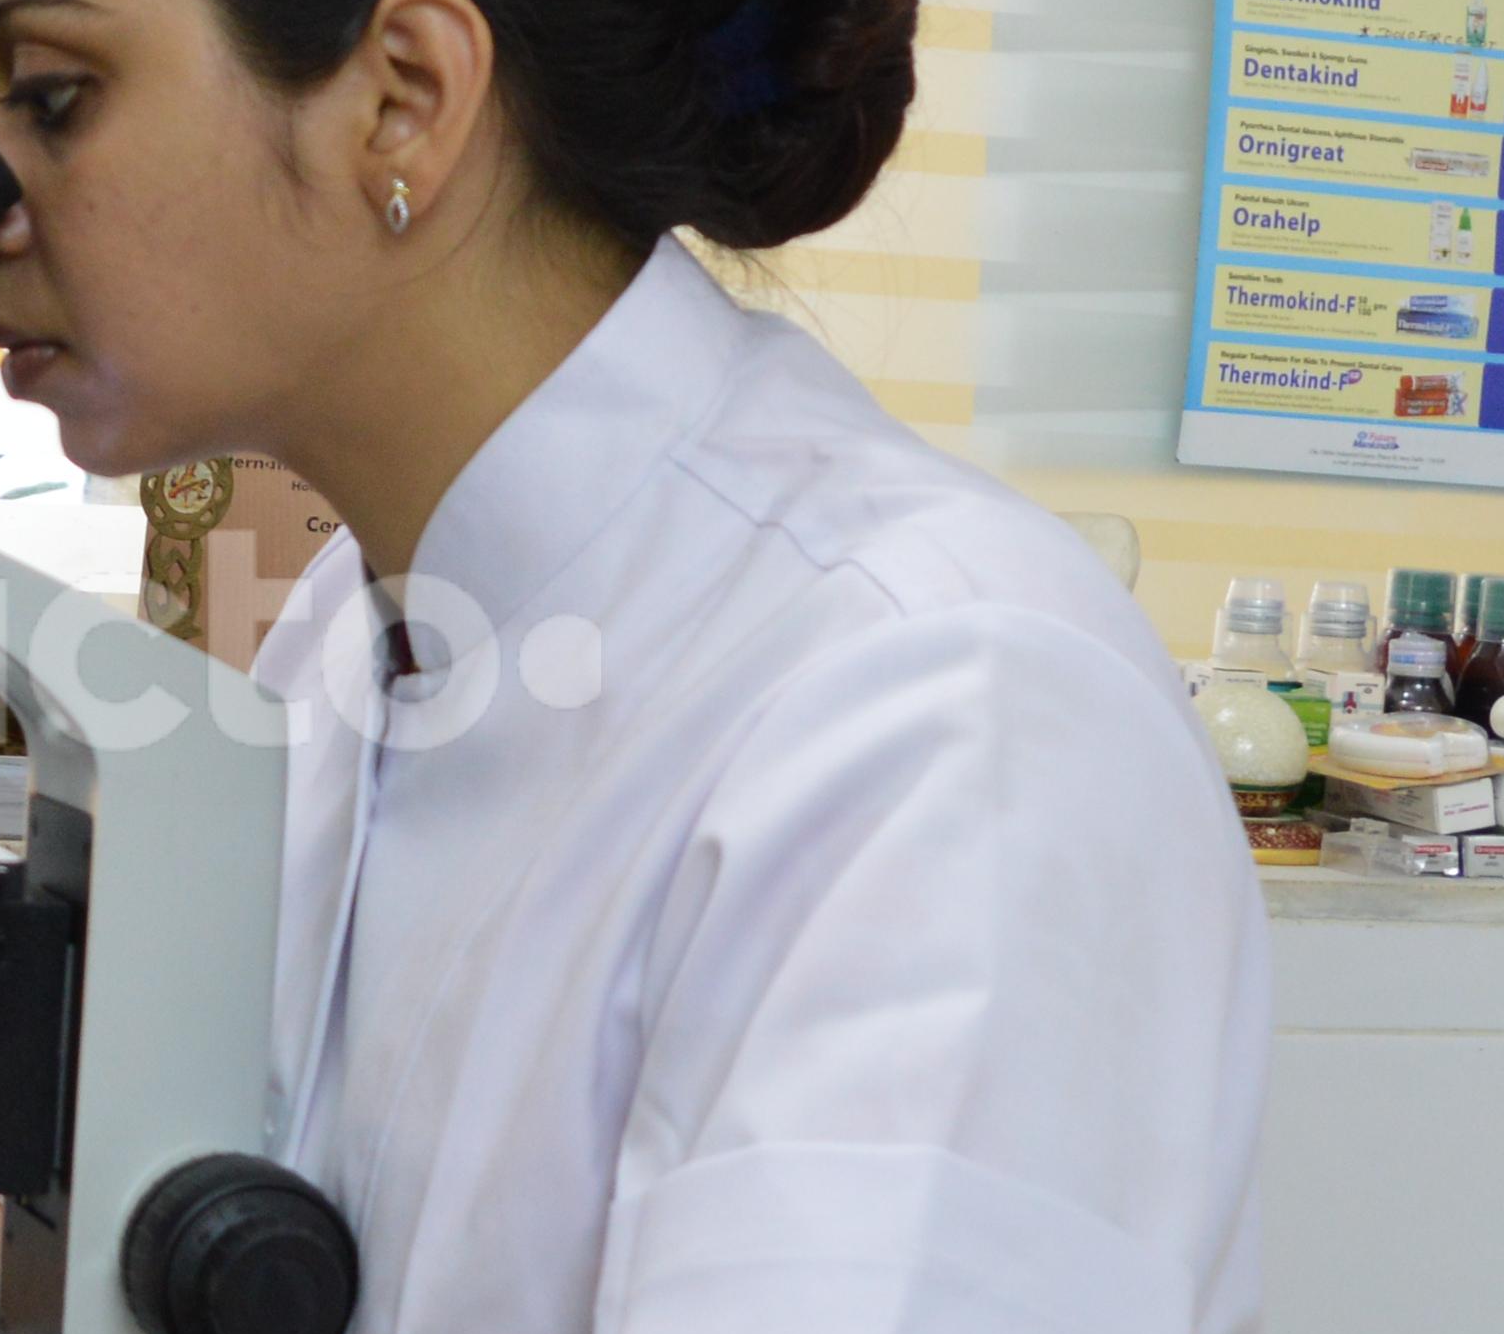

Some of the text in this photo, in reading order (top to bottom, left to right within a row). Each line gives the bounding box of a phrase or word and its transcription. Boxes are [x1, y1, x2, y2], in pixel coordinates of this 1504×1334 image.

[1244, 57, 1359, 88] Dentakind
[1238, 133, 1345, 163] Ornigreat
[1233, 207, 1320, 236] Orahelp
[1227, 285, 1355, 314] Thermokind-F
